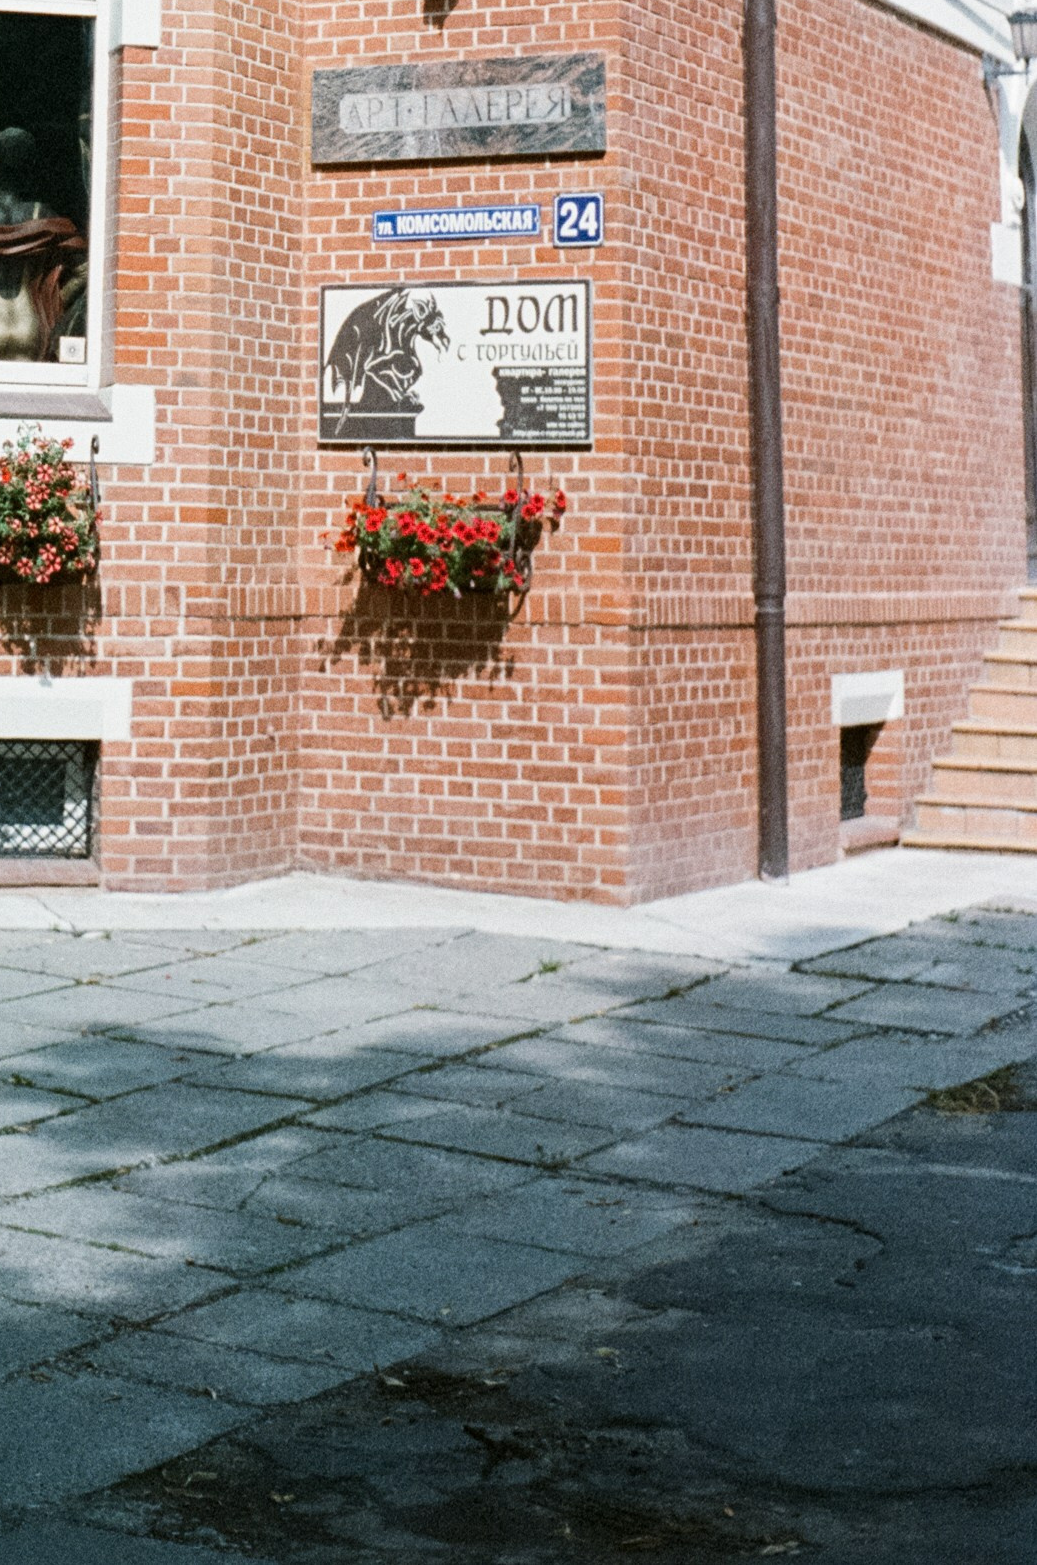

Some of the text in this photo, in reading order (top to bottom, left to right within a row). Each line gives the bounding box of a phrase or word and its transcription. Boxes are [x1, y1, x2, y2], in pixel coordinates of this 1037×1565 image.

[377, 209, 533, 235] ул. КОМСОМОЛЬСКАЯ
[559, 201, 598, 237] 24
[479, 293, 578, 336] ДОМ
